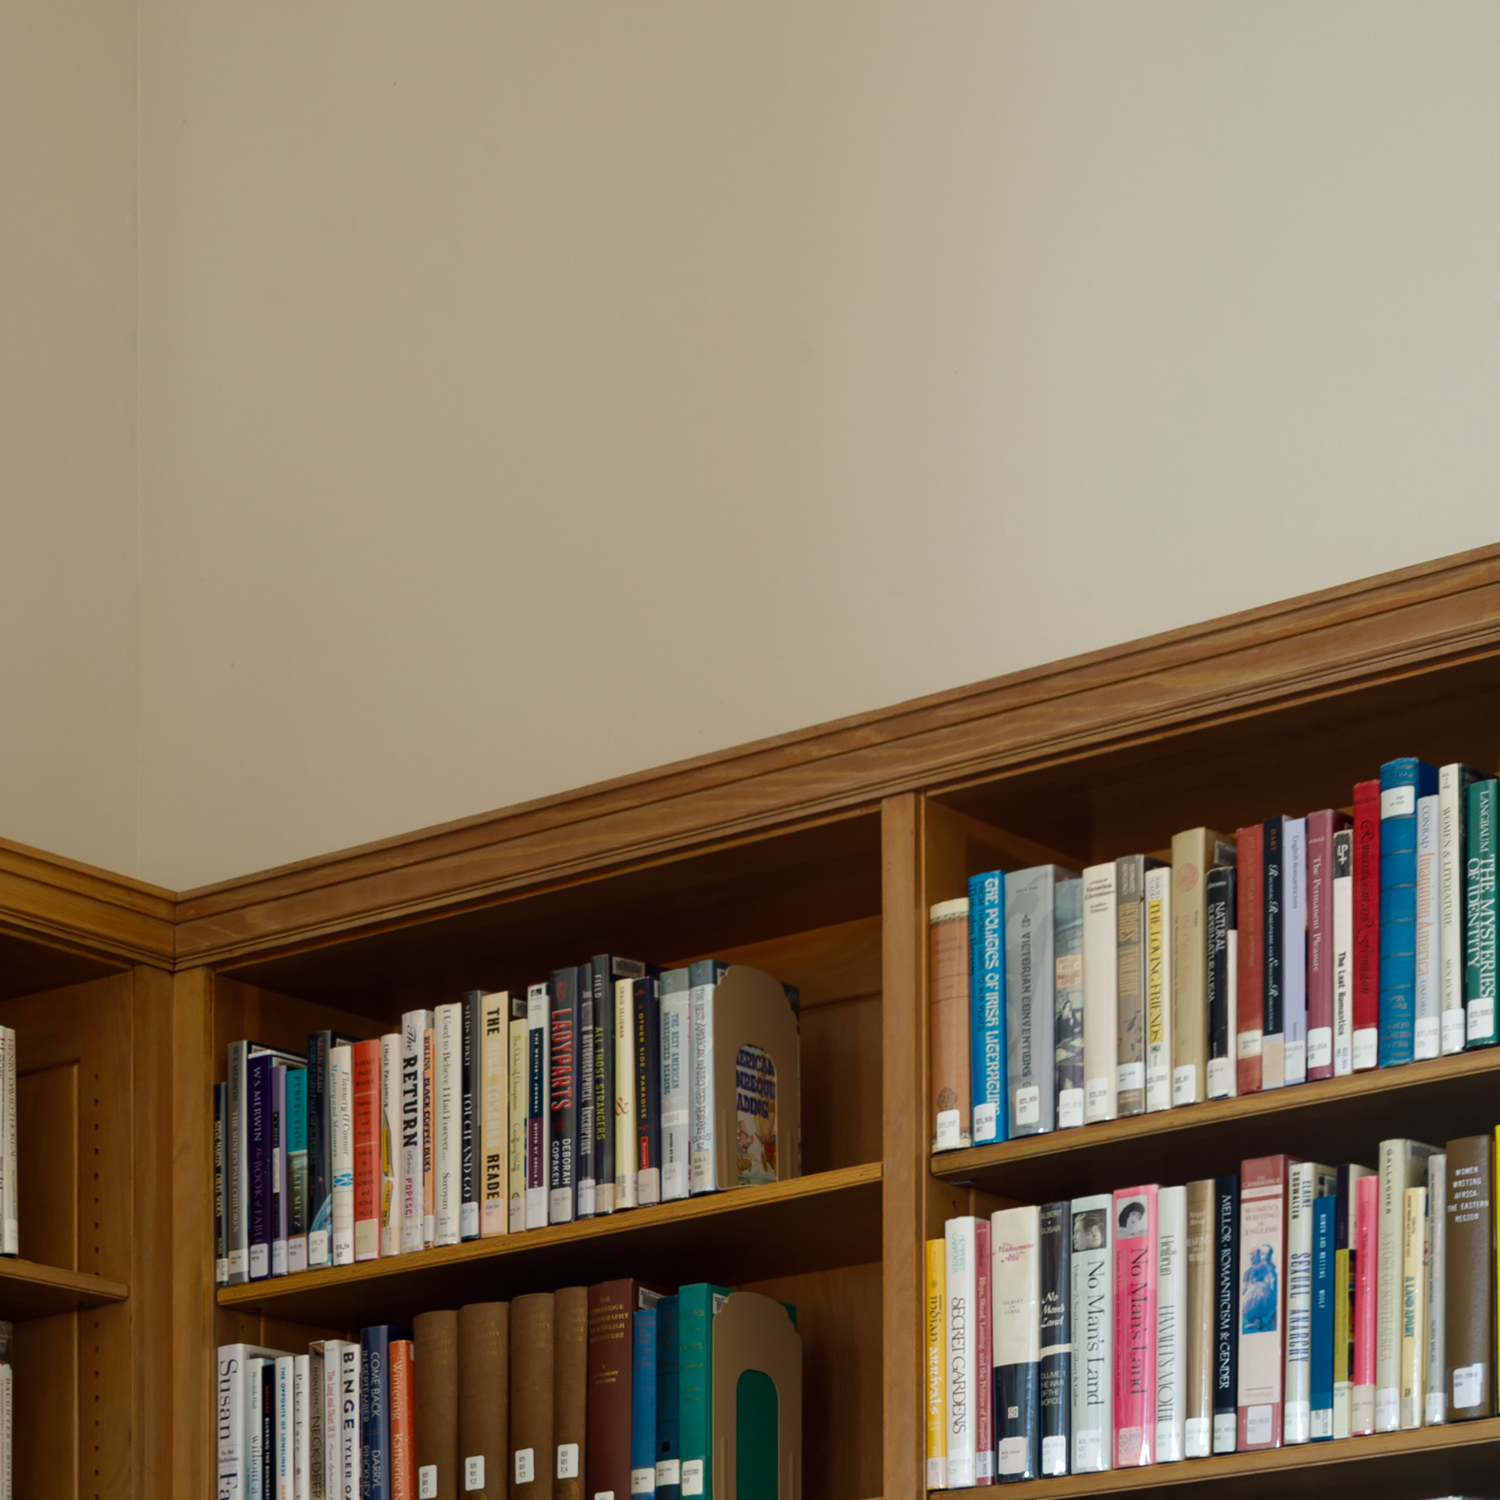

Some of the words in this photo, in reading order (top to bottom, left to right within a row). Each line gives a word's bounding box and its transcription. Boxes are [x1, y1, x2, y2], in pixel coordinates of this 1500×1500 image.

[1467, 857, 1479, 876] OF
[1480, 853, 1495, 893] THE
[1468, 881, 1480, 969] IDENTITY
[1480, 898, 1496, 997] MYSTERIES
[551, 1009, 573, 1111] LADYPARTS
[402, 1054, 418, 1147] RETURN
[1453, 1178, 1482, 1186] WRITING
[1454, 1190, 1477, 1199] AFRICA
[1455, 1167, 1478, 1176] WOMEN
[1220, 1195, 1231, 1242] MELLOR
[1448, 1204, 1458, 1212] THE
[1461, 1201, 1489, 1210] EASTERN
[1454, 1214, 1479, 1222] REGION
[1087, 1260, 1105, 1289] No
[1220, 1248, 1231, 1330] ROMANTICISM
[951, 1297, 966, 1353] SECRET
[1087, 1296, 1105, 1348] Man's
[1220, 1332, 1230, 1340] &
[1087, 1352, 1105, 1407] Land
[1220, 1342, 1230, 1389] GENDER
[220, 1359, 238, 1440] Susan
[343, 1352, 354, 1429] BINGE
[951, 1356, 966, 1434] GARDENS
